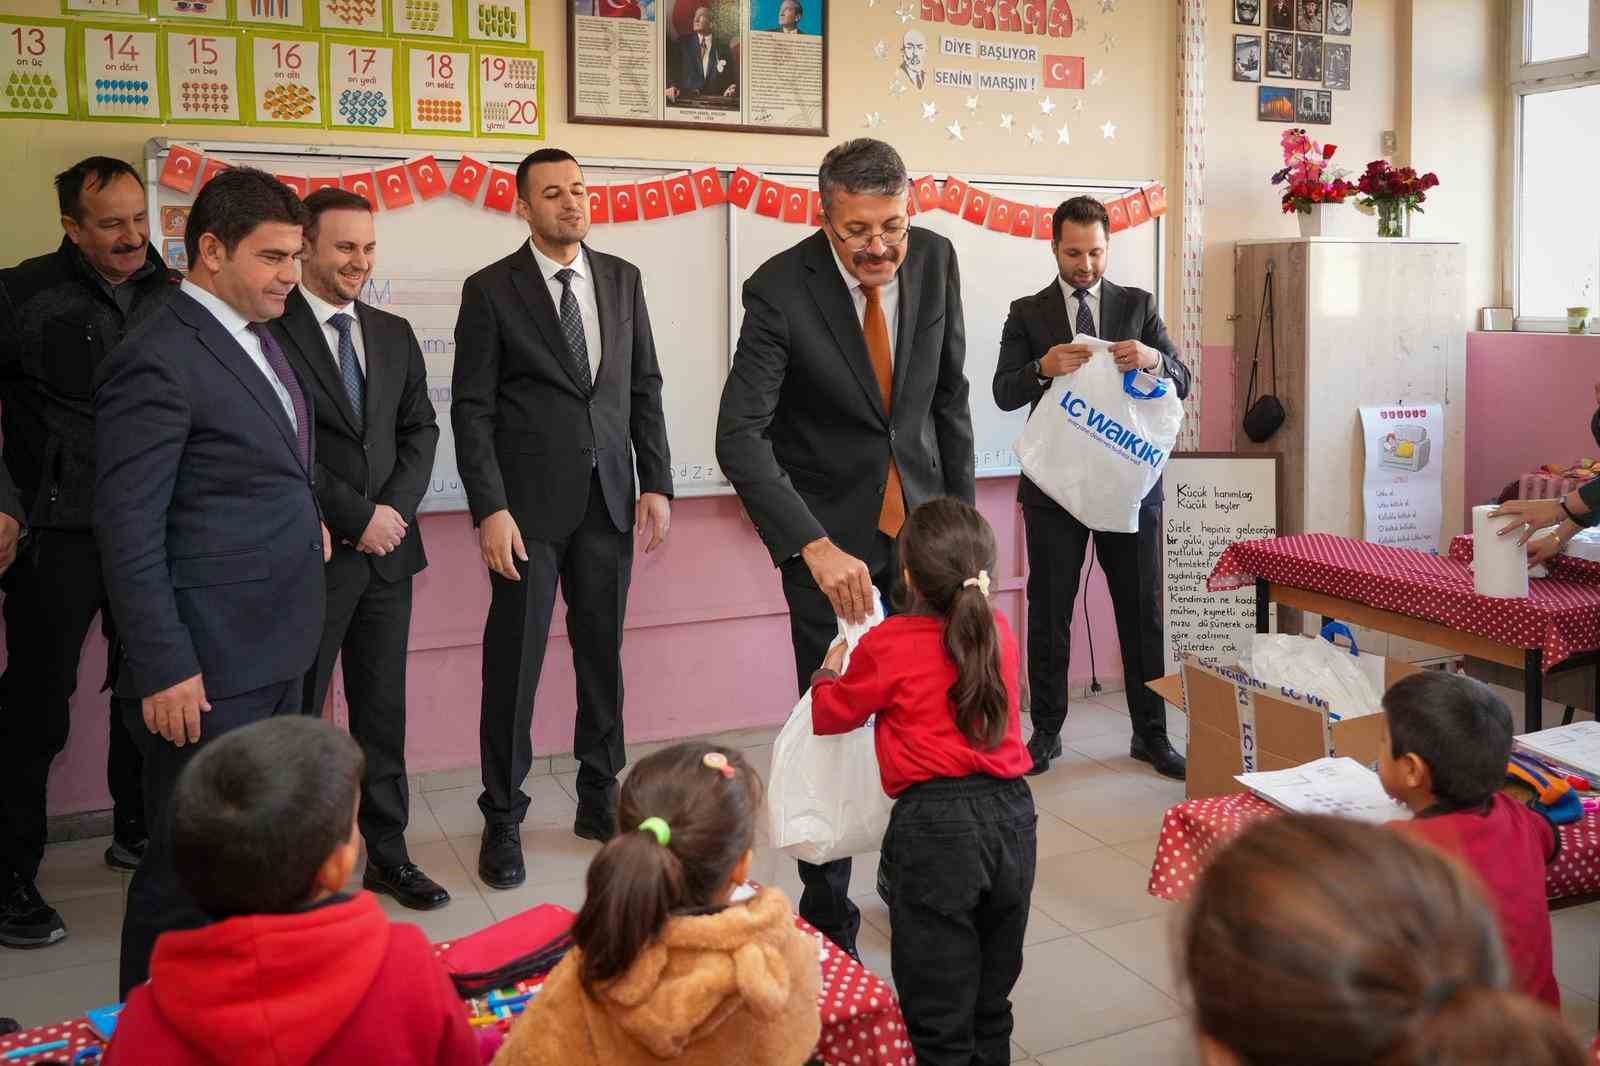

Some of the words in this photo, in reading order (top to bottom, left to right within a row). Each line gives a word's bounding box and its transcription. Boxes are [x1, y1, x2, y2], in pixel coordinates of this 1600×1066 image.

[11, 27, 46, 55] 13
[104, 33, 139, 61] 14
[187, 37, 218, 65] 15
[944, 40, 972, 55] DİYE
[979, 45, 1037, 61] BAŞLIYOR
[271, 42, 302, 69] 16
[348, 48, 377, 74] 17
[426, 53, 454, 79] 18
[481, 57, 506, 81] 19
[935, 70, 972, 86] SENİN
[980, 75, 1028, 91] MARŞIN
[507, 99, 538, 125] 20
[1060, 391, 1086, 417] LC
[1176, 483, 1207, 498] Küçük
[1215, 501, 1241, 513] beyler
[1166, 533, 1178, 545] bir
[1241, 608, 1256, 617] old
